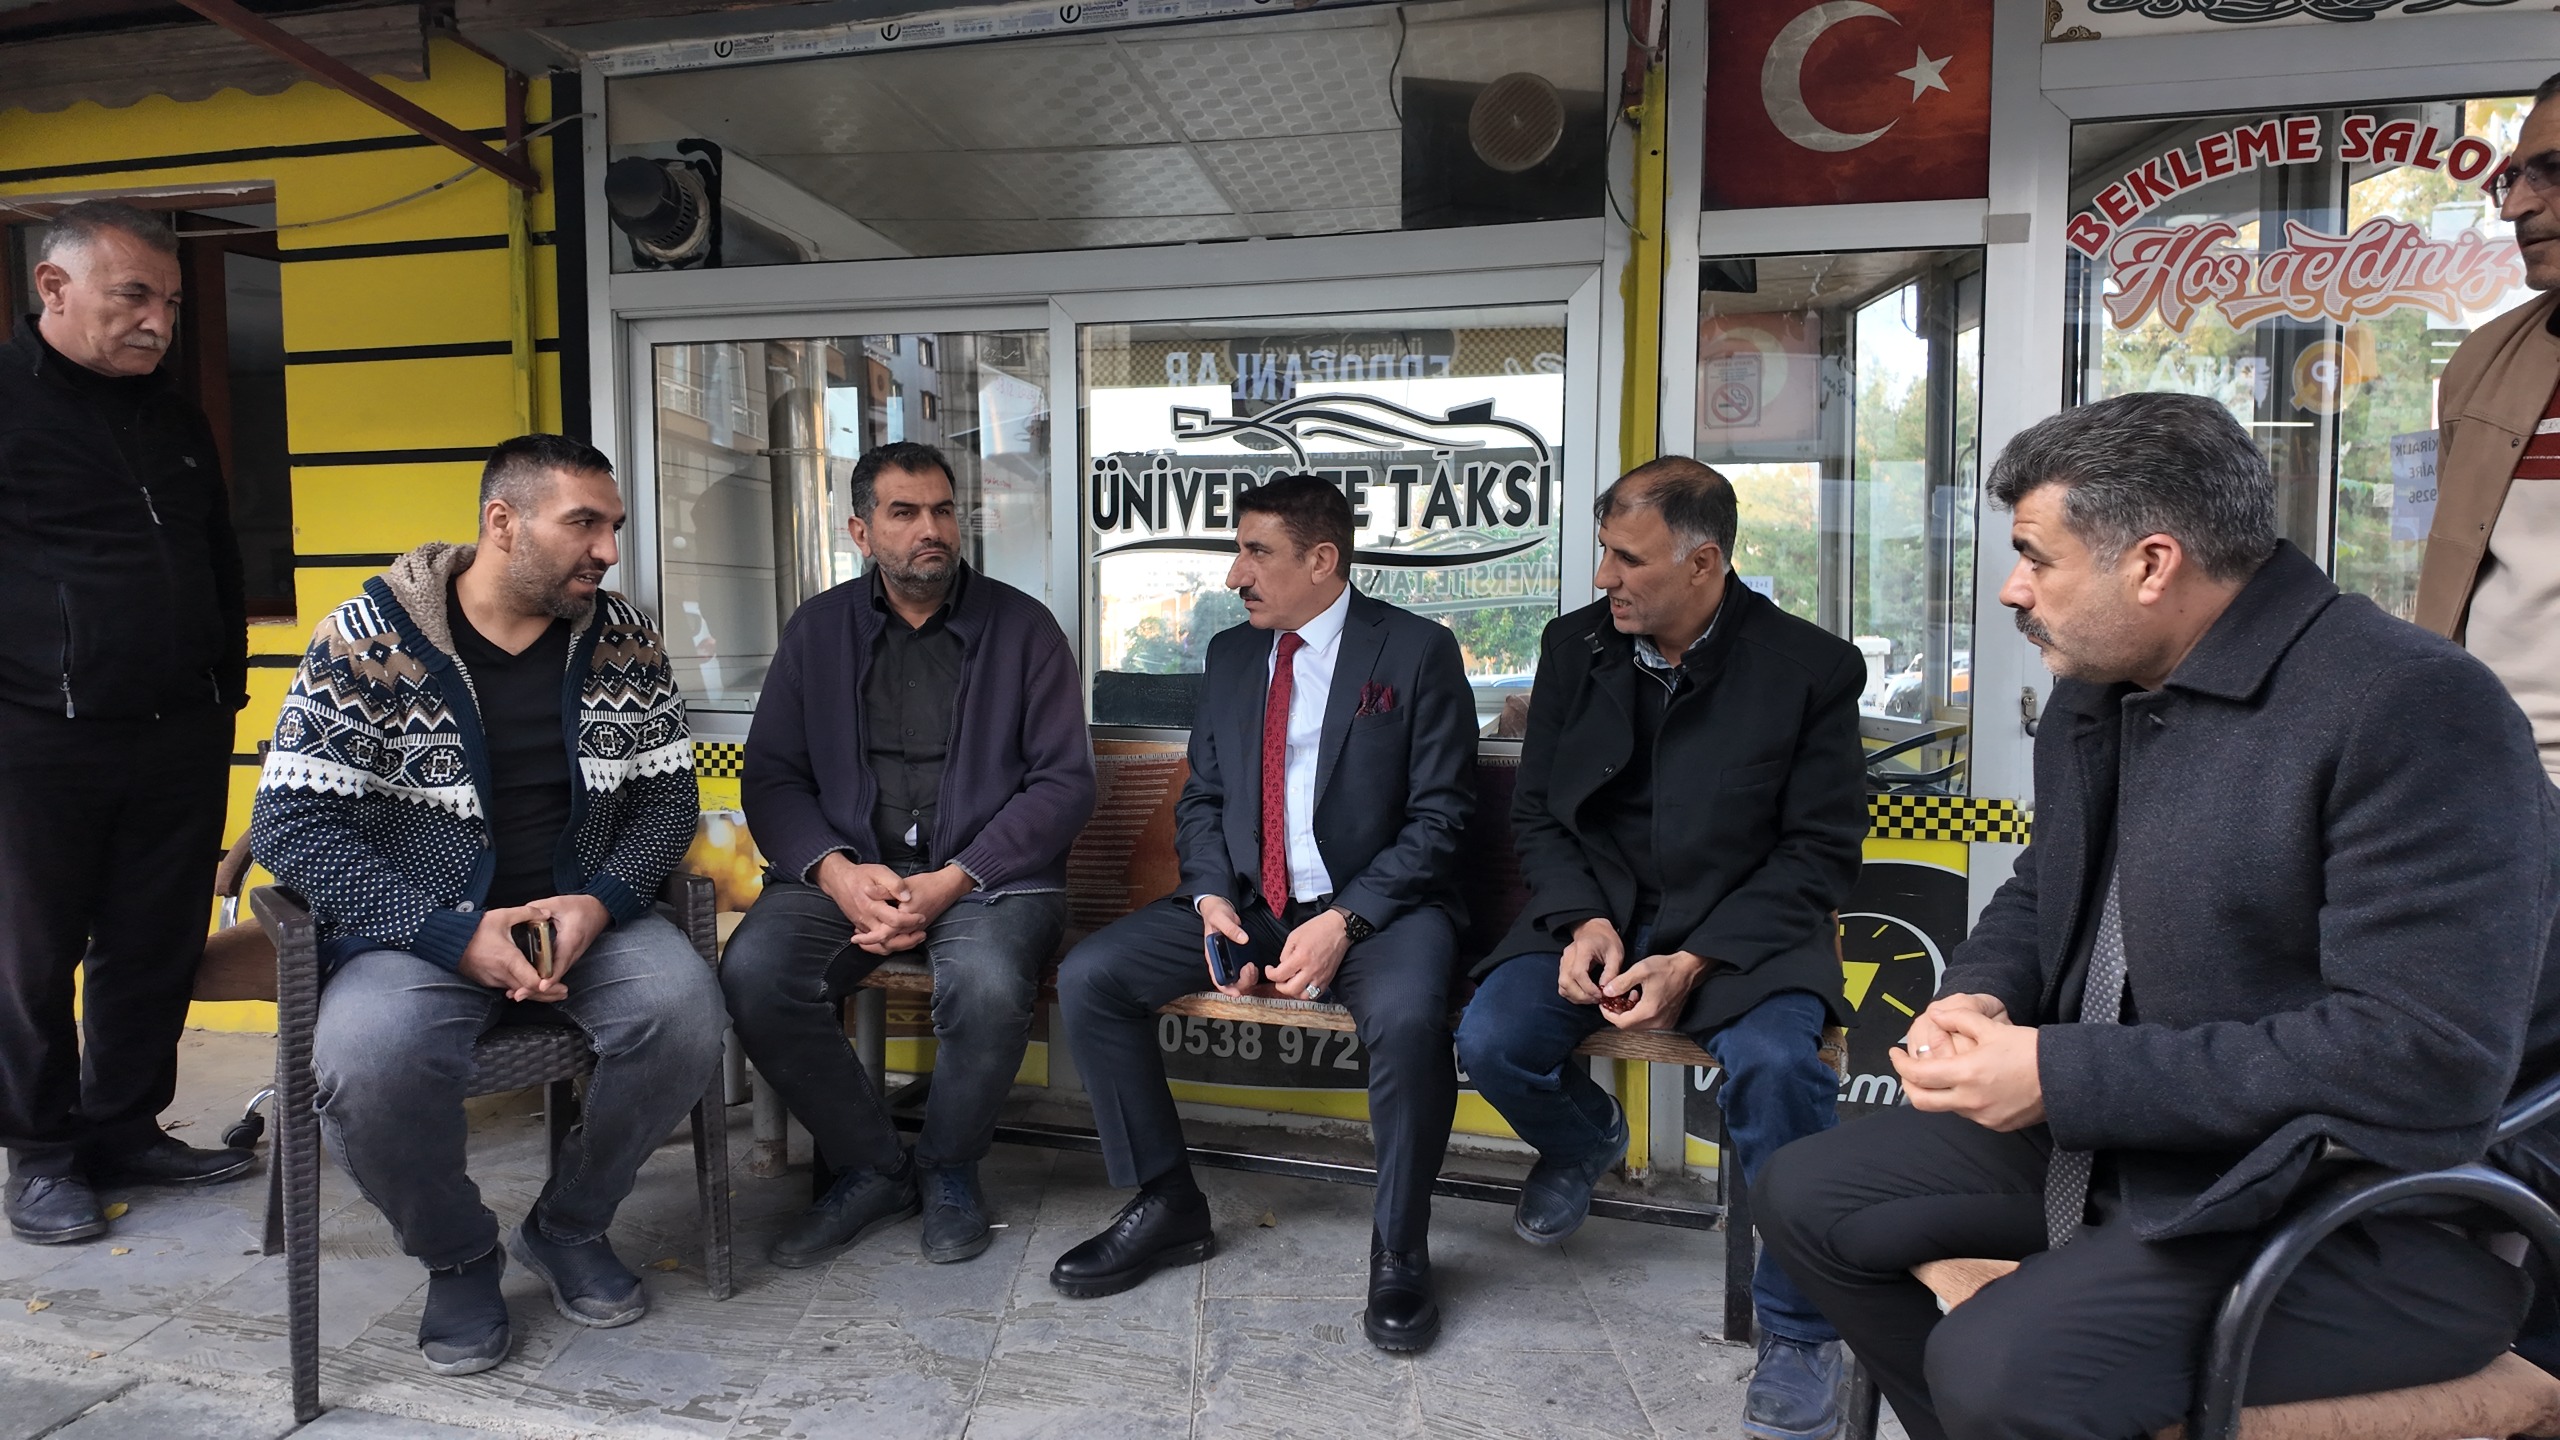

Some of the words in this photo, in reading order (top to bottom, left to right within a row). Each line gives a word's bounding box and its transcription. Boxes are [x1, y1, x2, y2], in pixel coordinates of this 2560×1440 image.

[2067, 116, 2321, 260] BEKLEME
[2103, 222, 2252, 335] Hoş
[1158, 1013, 1263, 1061] 0538
[1278, 1025, 1360, 1071] 972
